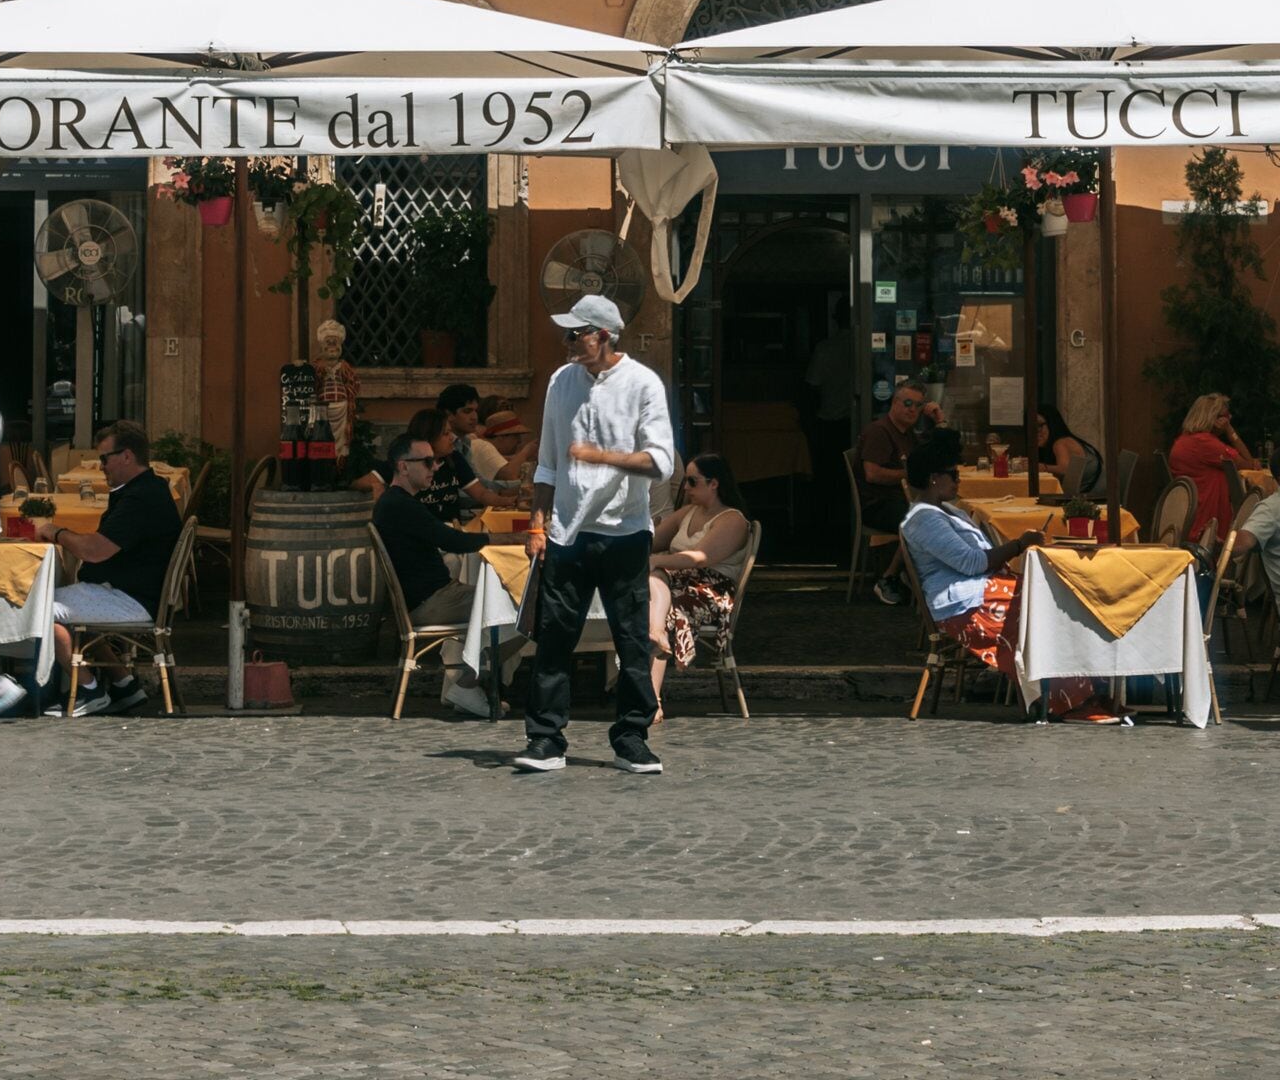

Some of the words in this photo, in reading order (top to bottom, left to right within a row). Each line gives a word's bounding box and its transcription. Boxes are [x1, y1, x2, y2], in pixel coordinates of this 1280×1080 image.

[327, 92, 420, 149] dal
[450, 90, 596, 148] 1952
[1011, 87, 1249, 139] TUCCI
[163, 337, 179, 357] E
[638, 333, 654, 352] F
[1070, 328, 1087, 348] G
[260, 548, 377, 610] TUCCI
[265, 614, 329, 630] RISTORANTE
[342, 613, 370, 629] 1952
